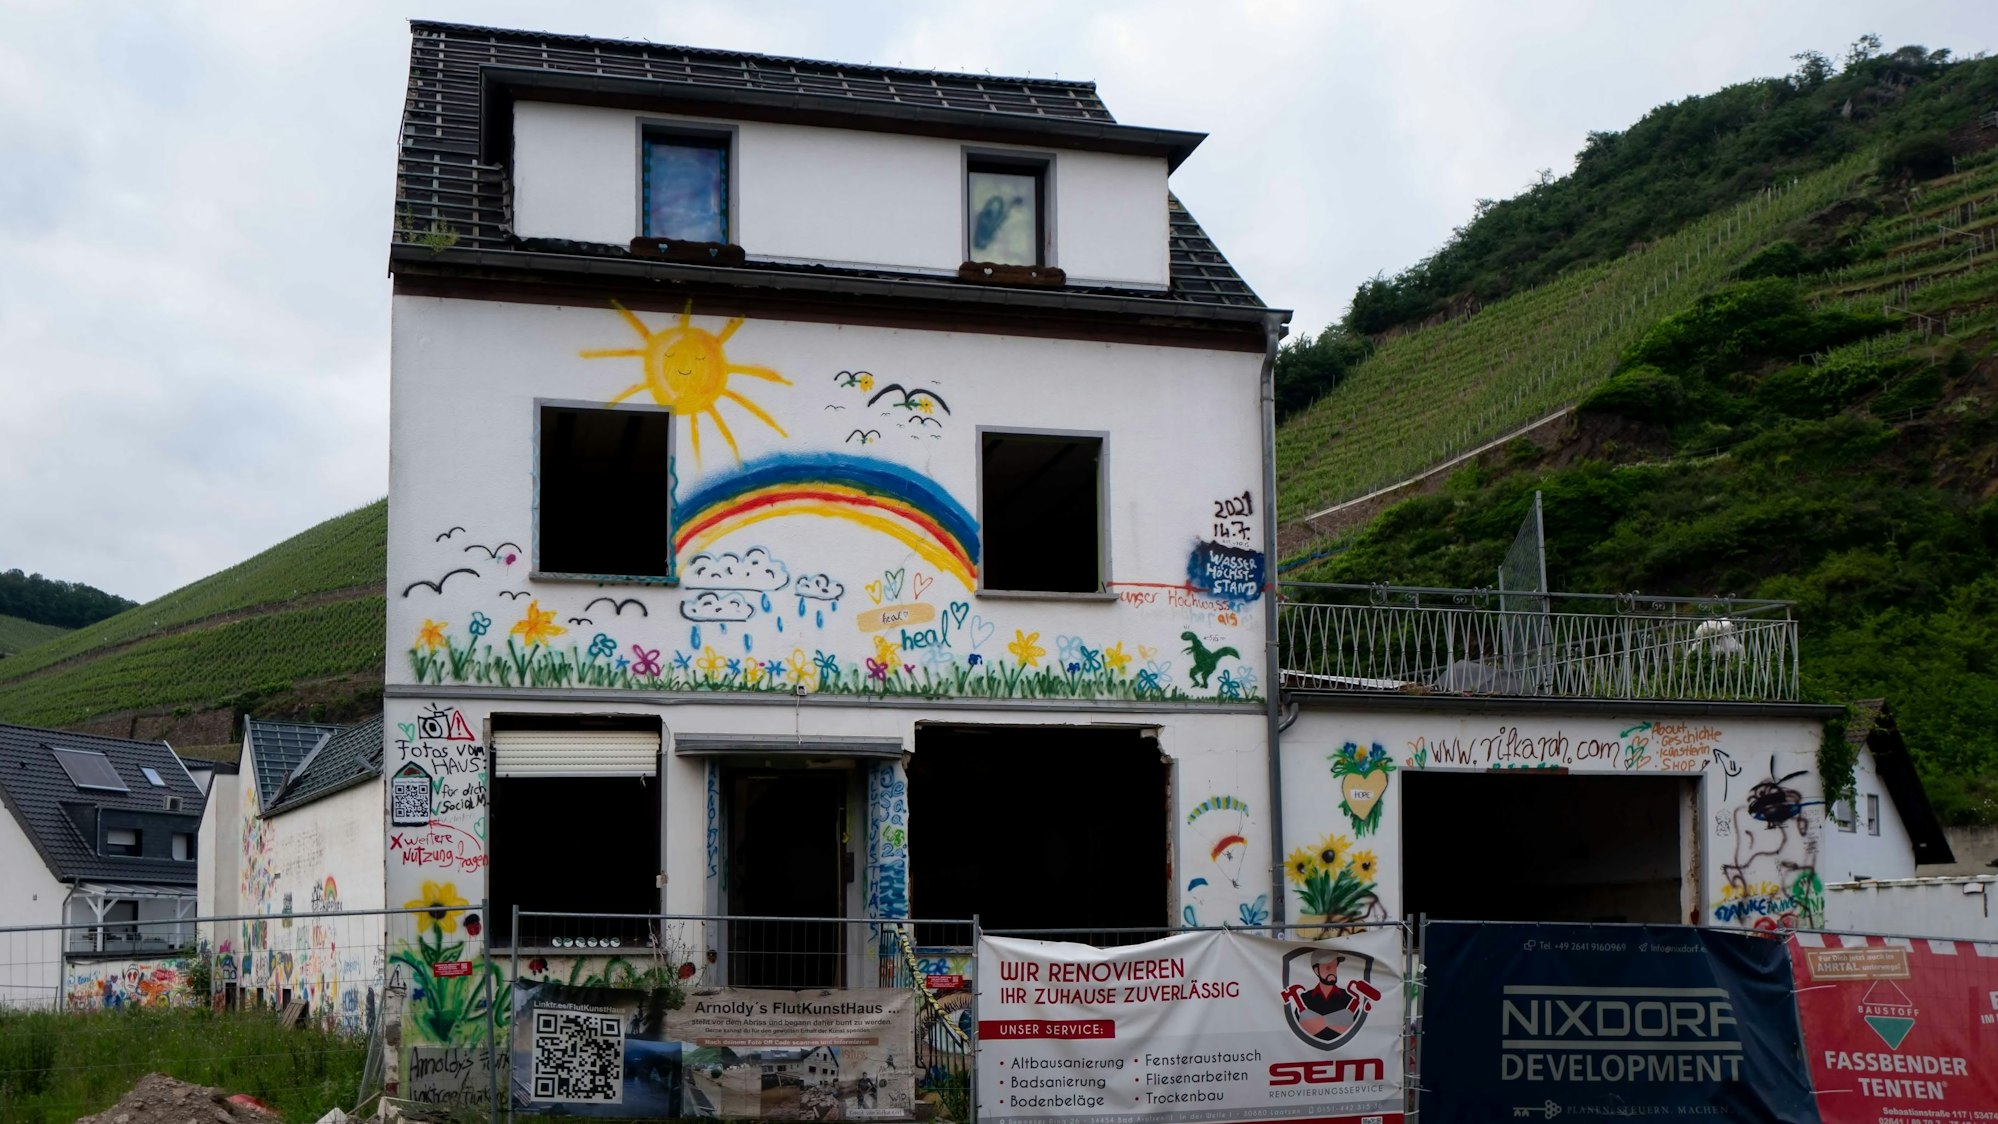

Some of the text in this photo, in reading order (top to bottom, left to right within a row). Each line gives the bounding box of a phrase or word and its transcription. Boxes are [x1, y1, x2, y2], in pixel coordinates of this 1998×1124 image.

[1214, 490, 1253, 519] 2021
[1214, 521, 1251, 541] 14.7.
[1209, 550, 1257, 571] WASSER
[1213, 579, 1258, 596] STAND
[901, 609, 951, 650] heal
[1652, 721, 1687, 737] About
[395, 739, 448, 760] Fotos
[1661, 758, 1696, 772] SHOP
[462, 781, 487, 796] dich
[402, 846, 453, 868] Nutzung
[1571, 942, 1590, 951] 2641
[1591, 943, 1627, 952] 9160969
[1000, 958, 1185, 983] WIR RENOVIEREN
[1817, 962, 1860, 972] AHRTAL
[1001, 980, 1240, 1005] IHR ZUHAUSE ZUVERLÄSSIG
[773, 1001, 883, 1015] FlutKunstHaus
[1857, 1005, 1920, 1016] BAUSTOFF
[785, 1019, 812, 1027] begann
[1502, 1000, 1738, 1037] NIXDORF
[1980, 1014, 1995, 1025] IM
[1000, 1023, 1104, 1036] UNSER SERVICE:
[1011, 1056, 1124, 1071] Altbausanierung
[1145, 1050, 1262, 1067] Fensteraustausch
[1824, 1050, 1968, 1076] FASSBENDER
[1502, 1054, 1744, 1082] DEVELOPMENT
[1011, 1075, 1106, 1090] Badsanierung
[1146, 1069, 1249, 1086] Fliesenarbeiten
[1146, 1089, 1224, 1105] Trockenbau
[1269, 1084, 1384, 1099] RENOVIERUNGSSERVICE
[1010, 1093, 1105, 1109] Bodenbeläge
[1882, 1107, 1951, 1118] Sebastianstraße
[1952, 1110, 1967, 1118] 117
